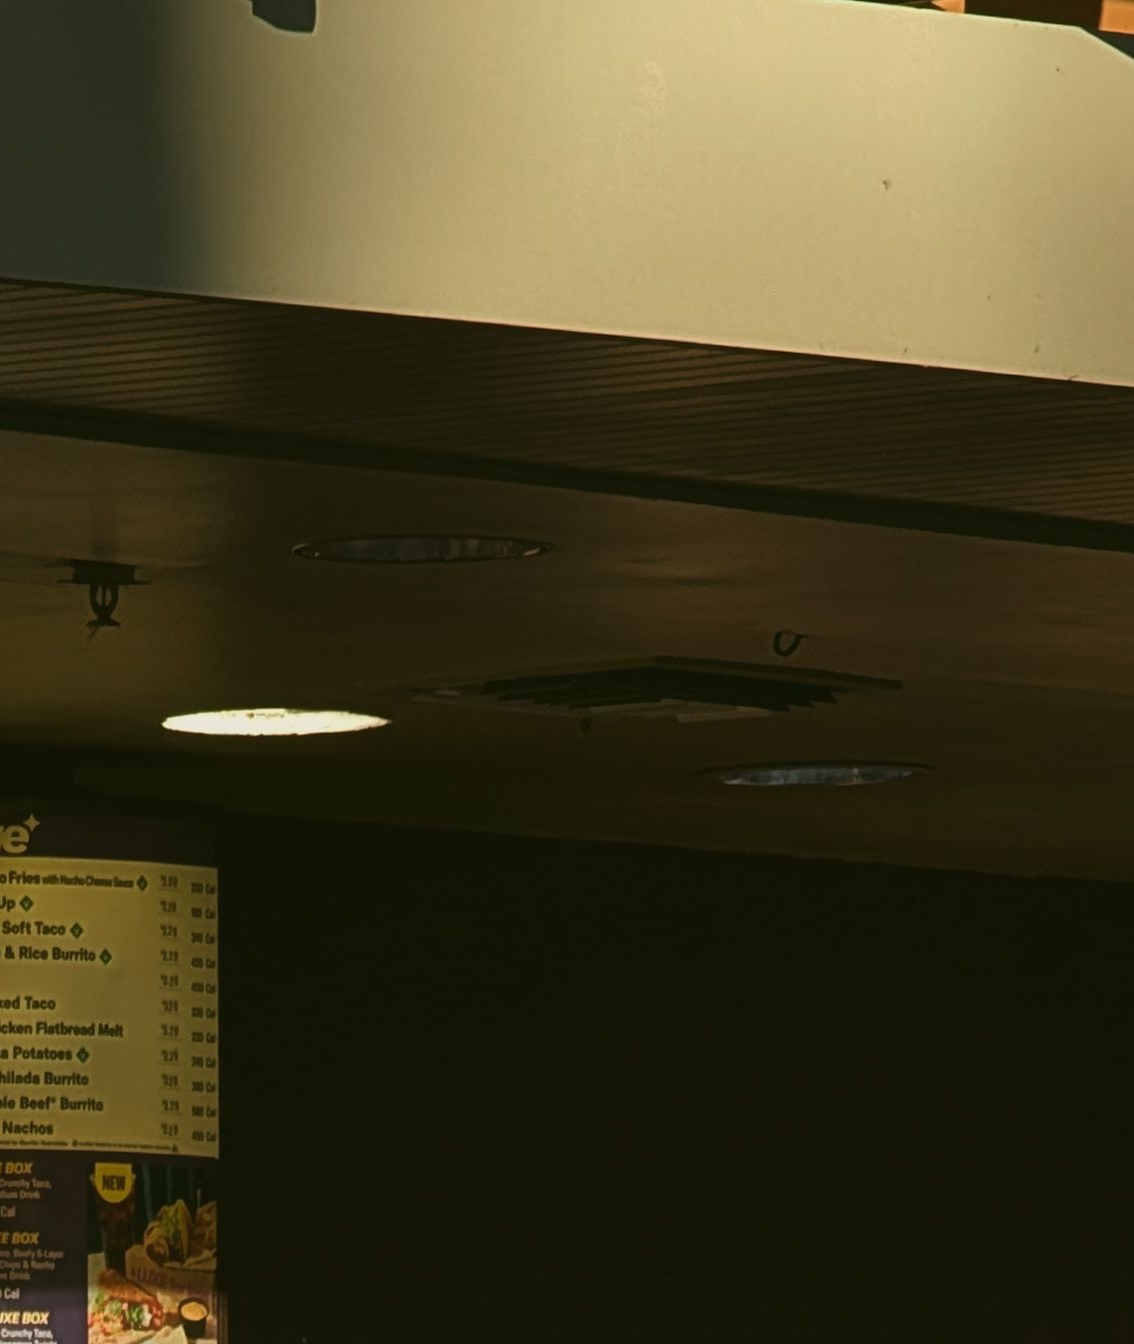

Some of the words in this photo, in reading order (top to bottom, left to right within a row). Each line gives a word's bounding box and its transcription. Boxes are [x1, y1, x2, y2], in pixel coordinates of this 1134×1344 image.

[9, 871, 40, 884] Fries
[2, 921, 31, 935] Soft
[34, 921, 66, 935] Taco
[4, 946, 15, 959] &
[19, 946, 48, 959] Rice
[52, 947, 96, 961] Burrito
[25, 996, 56, 1010] Taco
[36, 1022, 95, 1037] Flatbread
[98, 1023, 124, 1038] Melt
[13, 1046, 72, 1060] Potatoes
[44, 1072, 89, 1086] Burrito
[60, 1097, 104, 1112] Burrito
[2, 1121, 54, 1135] Nachos
[5, 1162, 34, 1174] BOX
[102, 1174, 126, 1191] NEW
[12, 1232, 40, 1244] BOX
[22, 1312, 50, 1325] BOX
